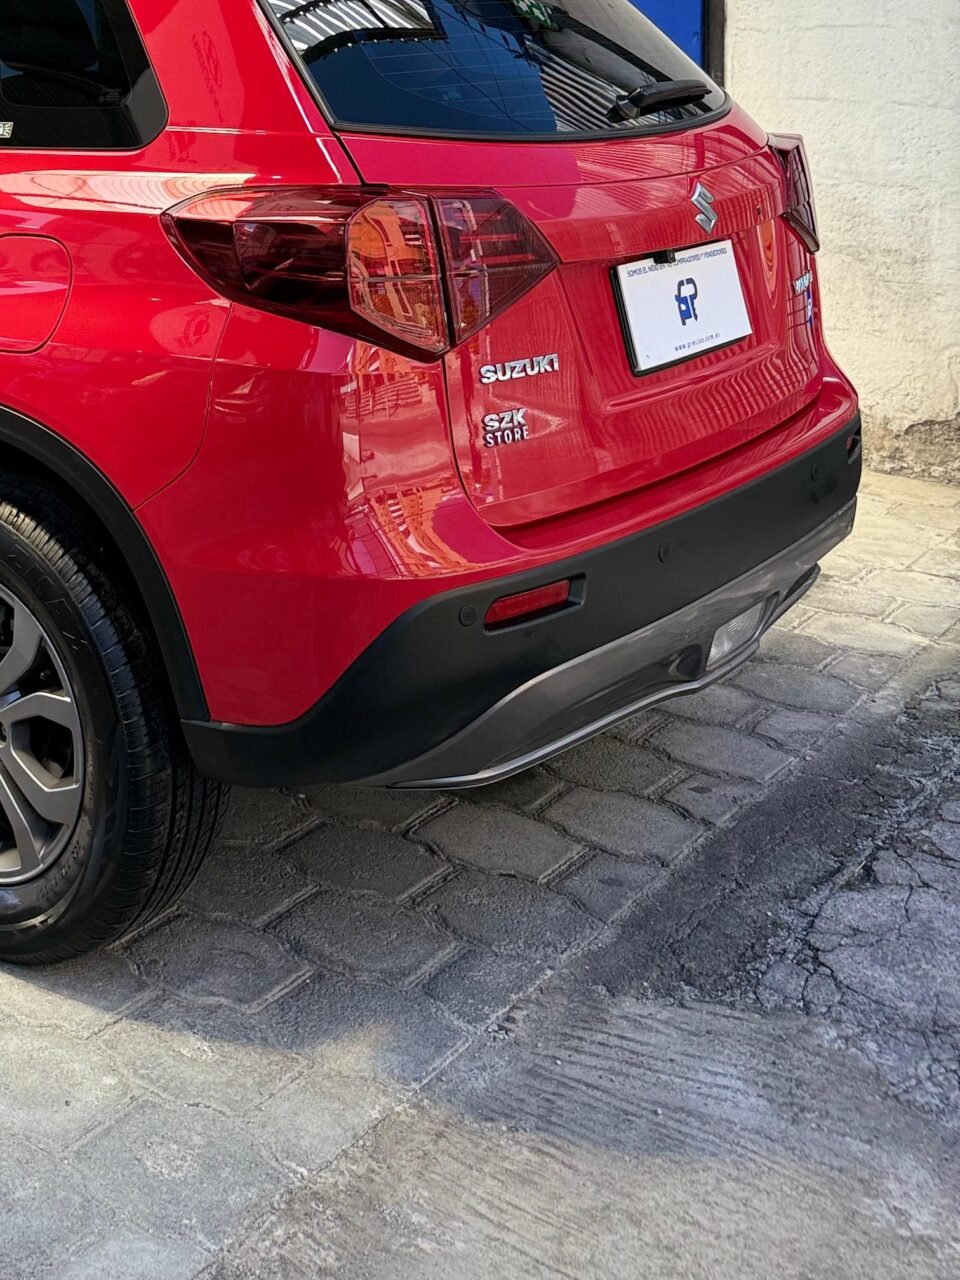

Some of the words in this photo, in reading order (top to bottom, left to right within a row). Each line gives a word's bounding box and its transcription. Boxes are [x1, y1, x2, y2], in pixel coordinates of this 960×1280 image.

[480, 353, 560, 384] SUZUKI
[483, 408, 527, 430] SZK
[484, 425, 529, 448] STORE
